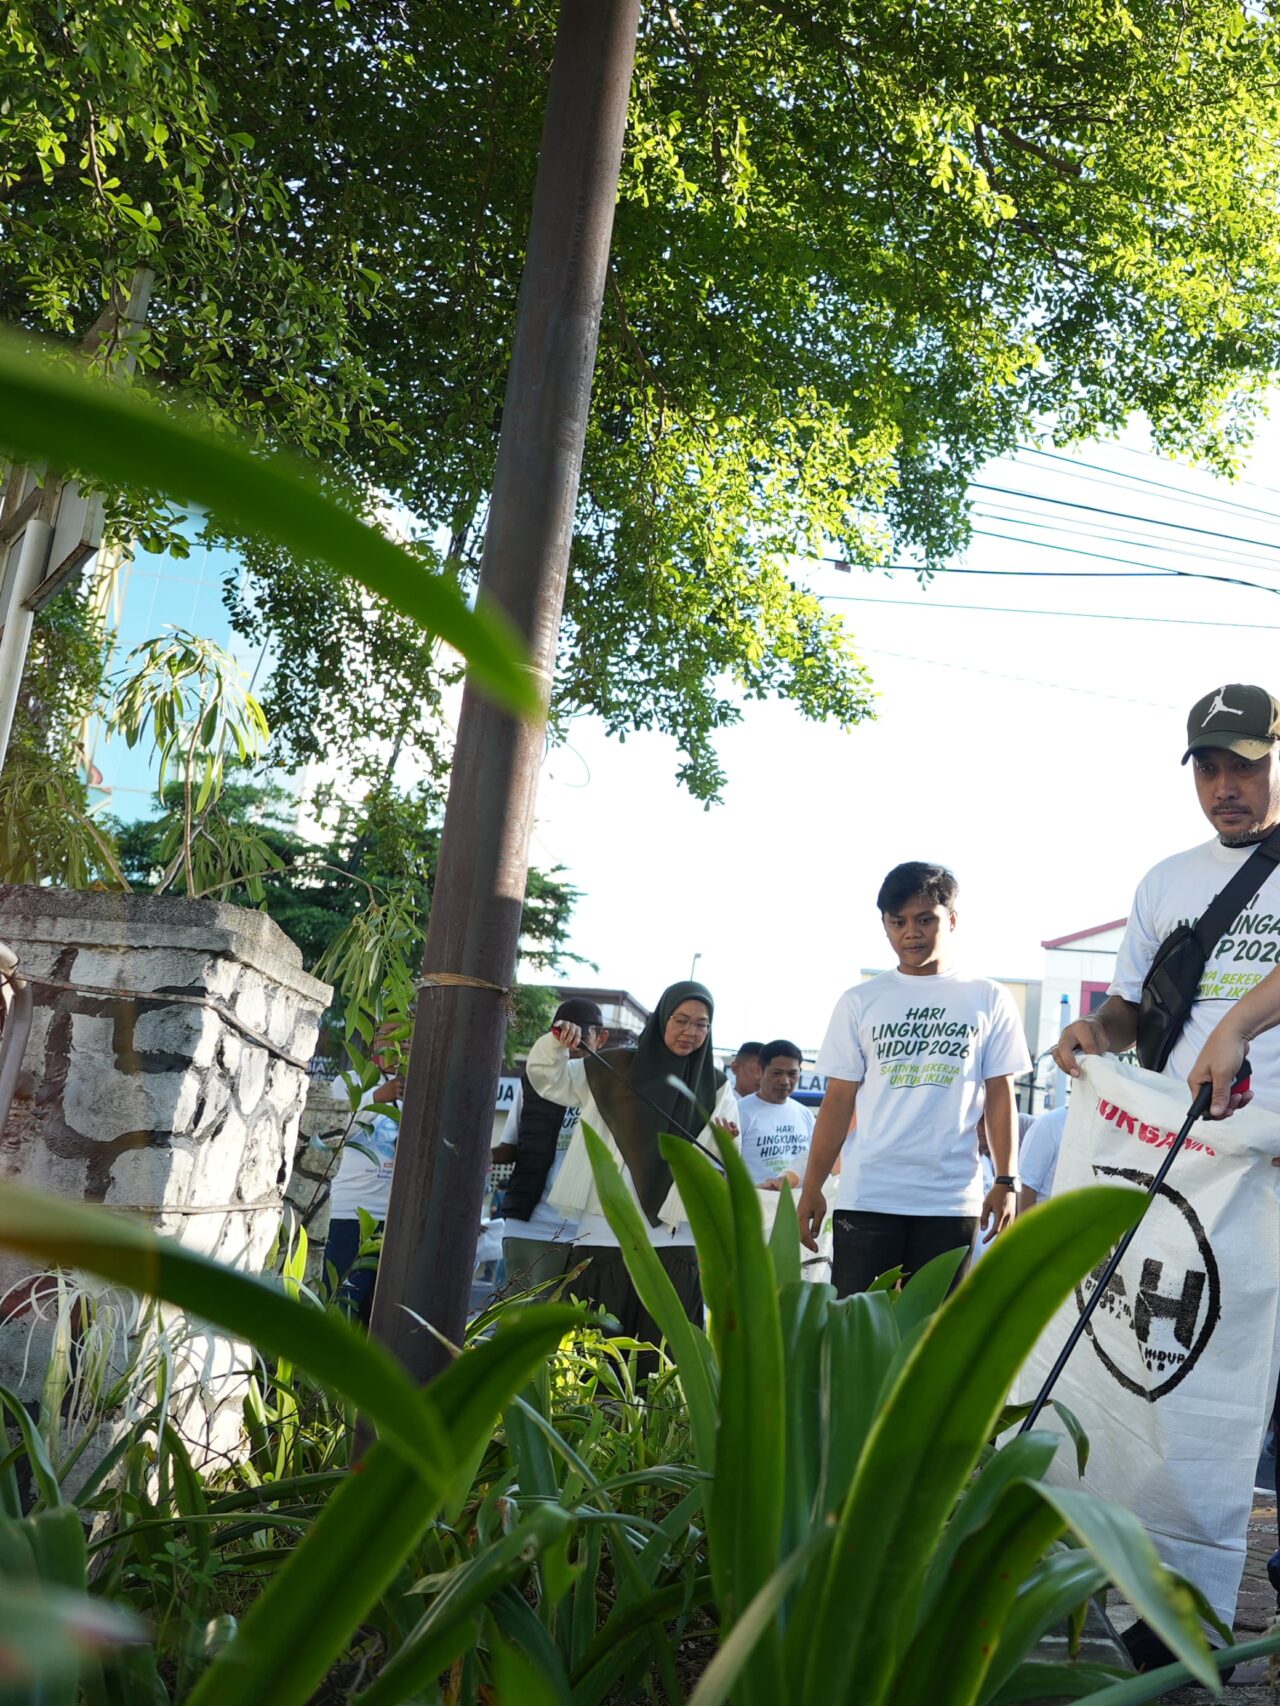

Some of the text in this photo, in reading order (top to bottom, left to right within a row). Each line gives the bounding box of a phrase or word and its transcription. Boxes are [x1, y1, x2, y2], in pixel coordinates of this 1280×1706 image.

[1220, 973, 1264, 985] BEKER
[905, 1007, 946, 1021] HARI
[877, 1040, 970, 1060] HIDUP 2026
[924, 1073, 954, 1085] IKLIM
[776, 1124, 795, 1133] HARI
[760, 1146, 791, 1158] HIDUP
[1144, 1347, 1186, 1365] HIDUP
